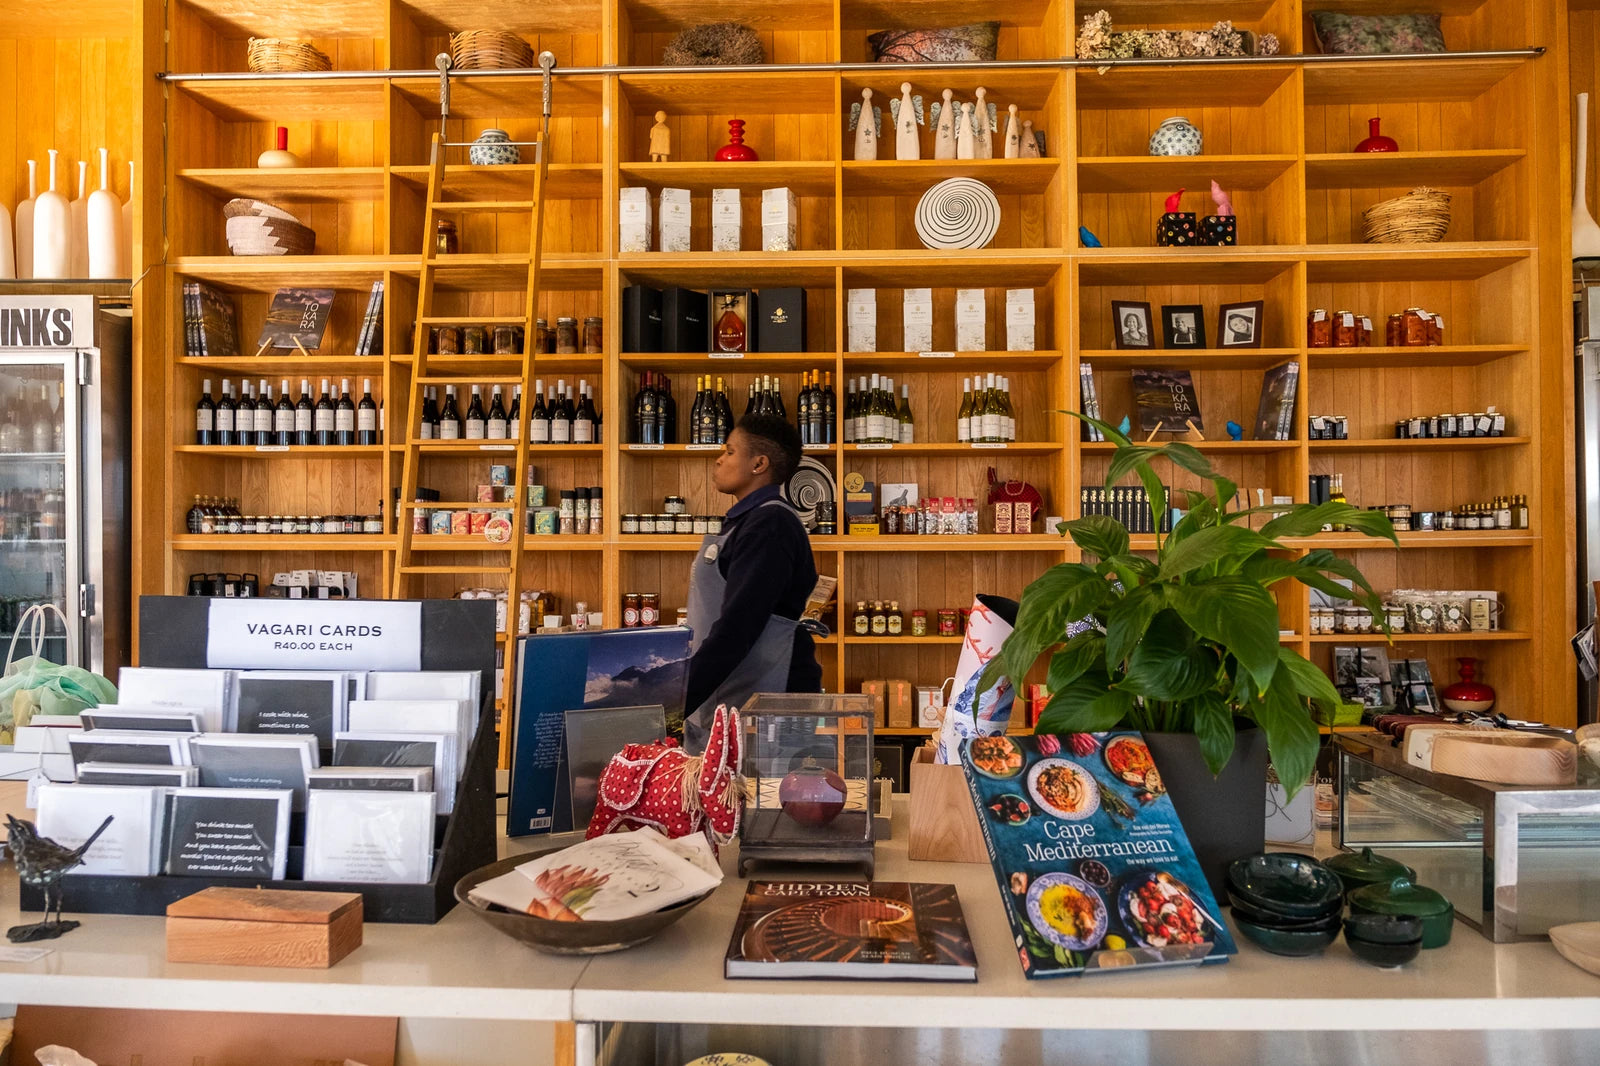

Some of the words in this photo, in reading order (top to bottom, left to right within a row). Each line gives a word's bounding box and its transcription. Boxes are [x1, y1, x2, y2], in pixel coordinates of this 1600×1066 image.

[304, 302, 320, 312] TO
[302, 311, 317, 320] KA
[1, 308, 72, 346] INKS
[299, 320, 315, 329] RA
[1167, 384, 1184, 394] TO
[1172, 393, 1189, 403] KA
[1174, 402, 1191, 412] RA
[247, 623, 313, 636] VAGARI
[319, 625, 382, 637] CARDS
[274, 641, 316, 650] R40.00
[319, 642, 353, 651] EACH
[960, 750, 971, 778] Cape
[969, 777, 997, 862] Mediterranean
[1043, 820, 1096, 845] Cape
[1022, 838, 1175, 862] Mediterranean
[767, 883, 869, 891] HIDDEN
